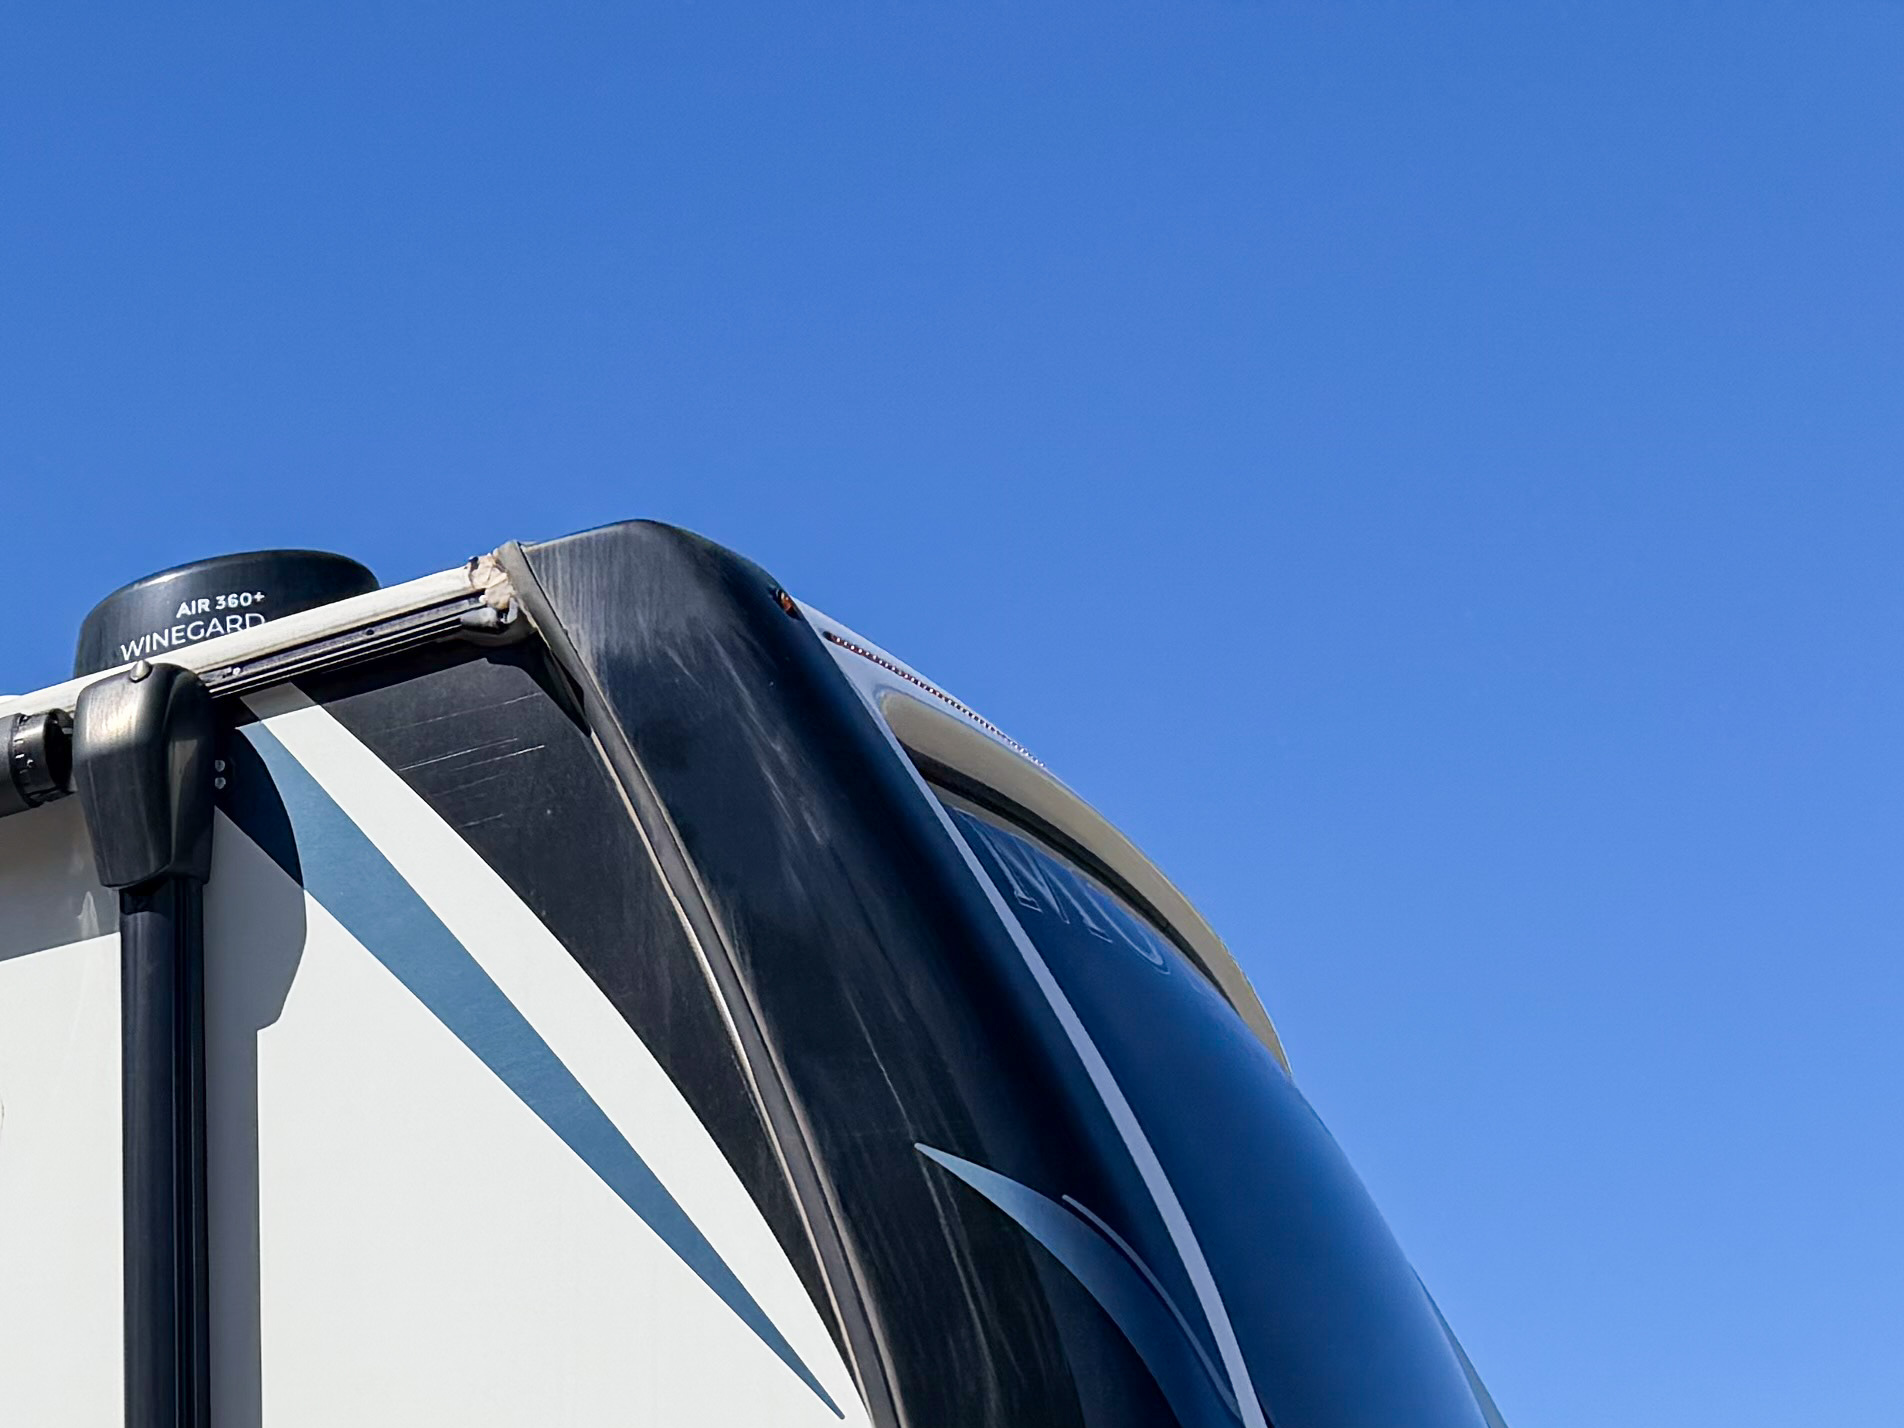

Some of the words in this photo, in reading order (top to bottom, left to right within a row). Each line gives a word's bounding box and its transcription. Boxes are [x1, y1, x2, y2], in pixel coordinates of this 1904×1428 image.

[176, 598, 210, 618] AIR
[216, 591, 265, 610] 360+
[120, 613, 266, 661] WINEGARD
